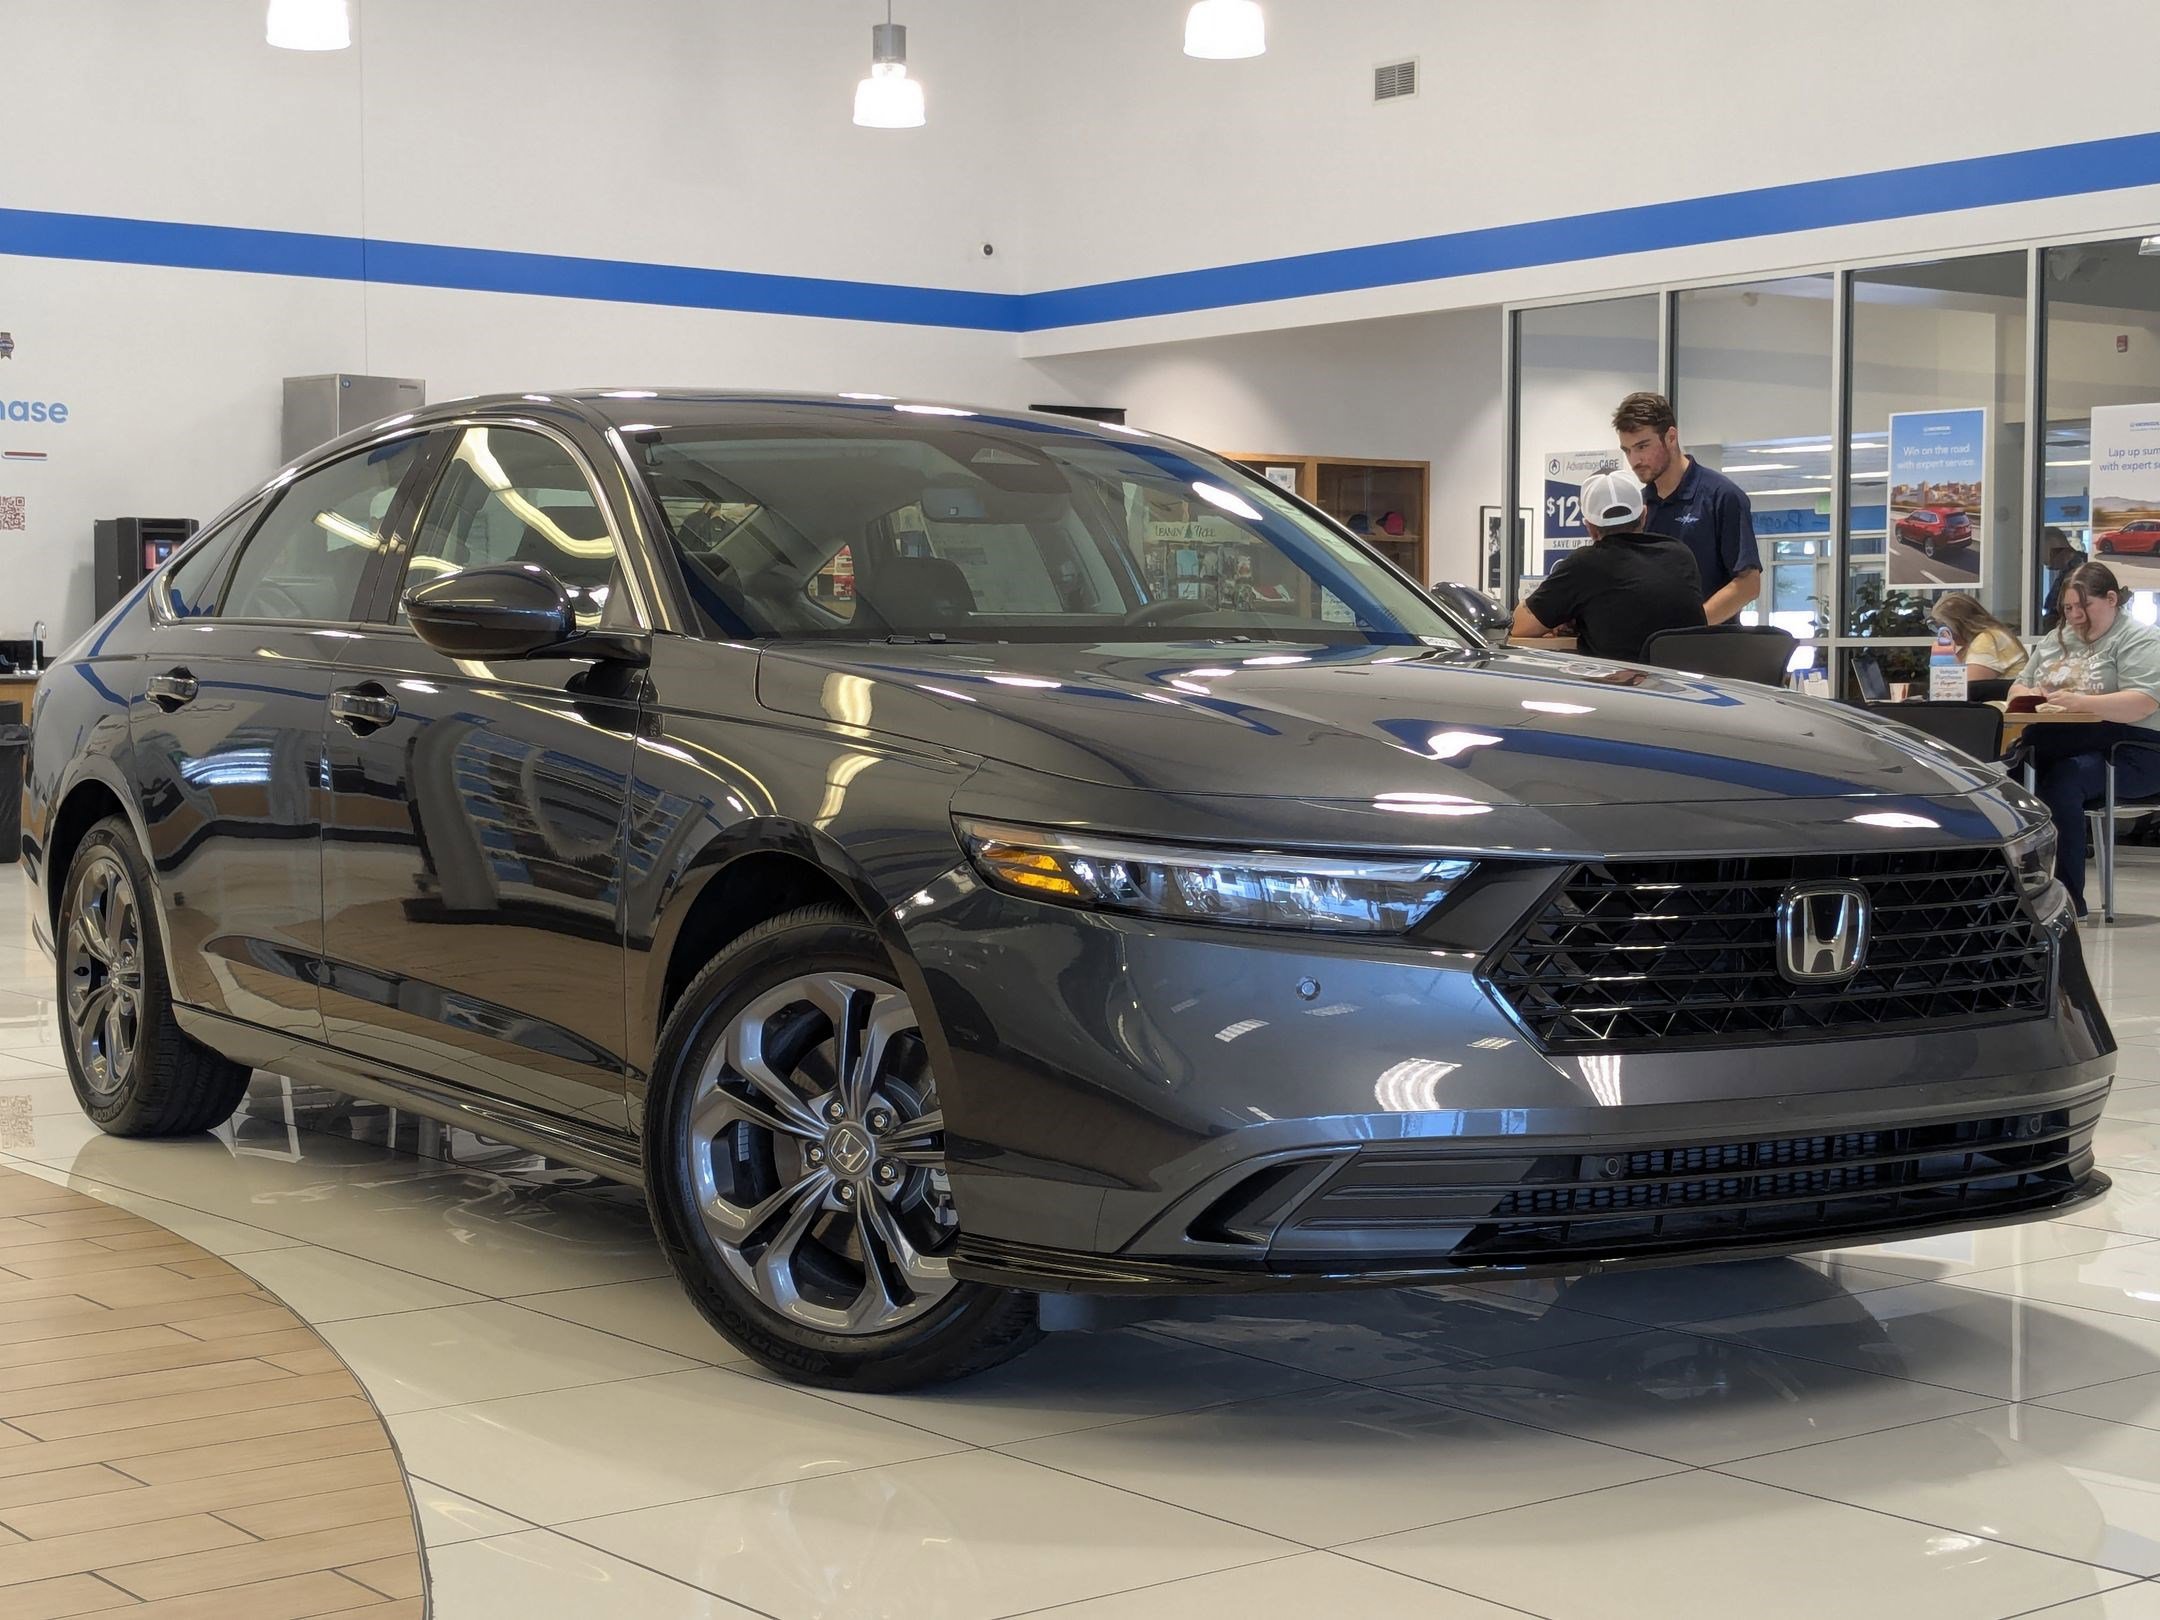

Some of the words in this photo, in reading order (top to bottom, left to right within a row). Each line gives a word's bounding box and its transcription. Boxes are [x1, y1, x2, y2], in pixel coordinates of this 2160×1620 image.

[0, 400, 69, 424] ase
[1903, 446, 1920, 457] Win
[1921, 447, 1933, 456] on
[1934, 444, 1949, 455] the
[1950, 442, 1970, 454] road
[2108, 447, 2126, 459] Lap
[2127, 448, 2141, 459] up
[1897, 459, 1914, 470] with
[1915, 458, 1944, 471] expert
[1945, 457, 1976, 468] service
[2099, 460, 2119, 471] with
[2121, 460, 2152, 473] expert
[1546, 495, 1581, 528] $12
[1552, 540, 1569, 549] SAVE
[1572, 540, 1582, 548] UP
